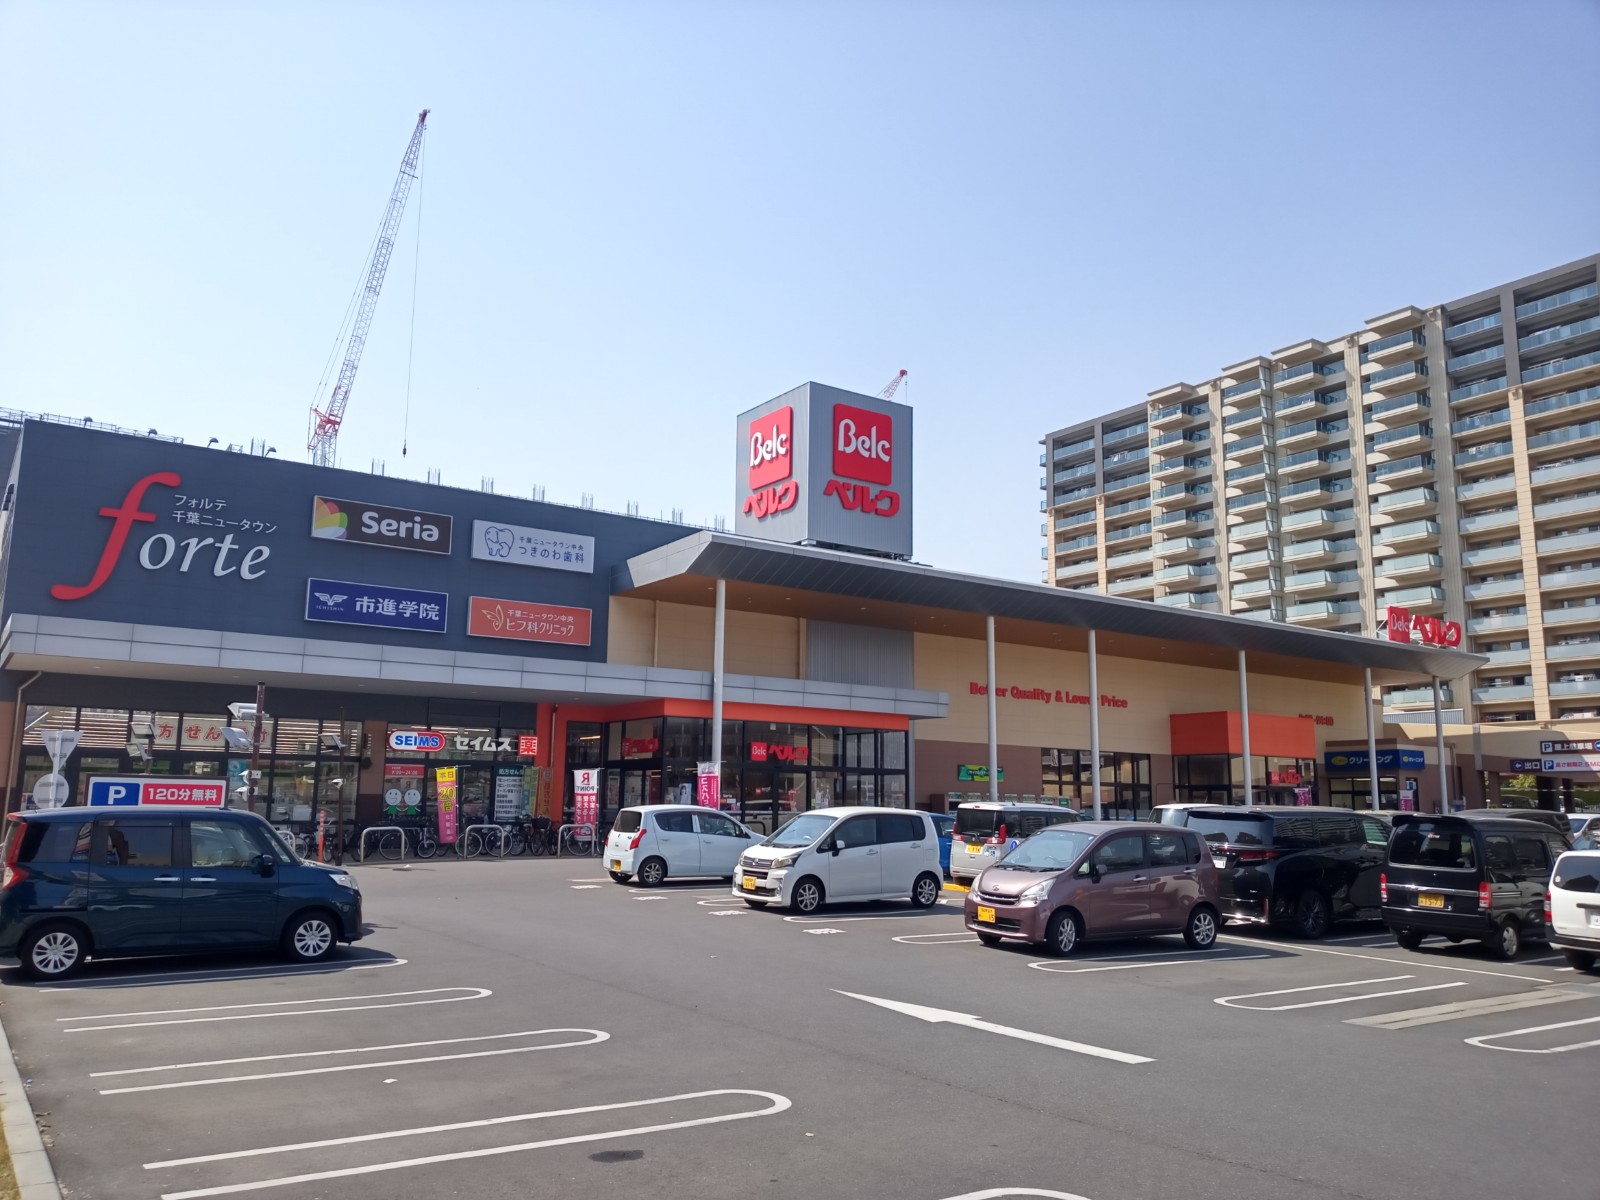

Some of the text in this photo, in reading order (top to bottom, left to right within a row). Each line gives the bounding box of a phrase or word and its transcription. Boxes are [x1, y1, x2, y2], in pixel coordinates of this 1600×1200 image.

[750, 424, 788, 467] Belc
[838, 418, 891, 463] Belc
[174, 494, 228, 512] フォルテ
[743, 480, 799, 519] ベルク
[823, 479, 901, 518] ベルク
[171, 510, 278, 535] 千葉ニュータウン
[361, 511, 440, 542] Seria
[51, 472, 271, 600] forte
[519, 536, 584, 552] 千葉ニュータウン中央
[518, 546, 585, 564] つきのわ歯科
[355, 596, 440, 621] 市進学院
[507, 609, 574, 623] 千葉ニュータウン中央
[506, 618, 575, 637] ヒフ科クリニック
[1391, 613, 1409, 632] Belc
[1410, 615, 1461, 647] ベルク
[970, 682, 1008, 697] Beer
[1011, 685, 1052, 704] Quality
[1055, 690, 1063, 703] &
[1101, 695, 1128, 708] Price
[394, 735, 440, 747] SEIMS
[454, 735, 512, 752] セイムス
[520, 736, 538, 755] 薬
[1544, 743, 1551, 752] P
[769, 745, 809, 760] ベルク
[1349, 755, 1393, 765] クリーング
[1545, 761, 1553, 769] P
[108, 786, 127, 805] P
[148, 787, 217, 802] 120分無料
